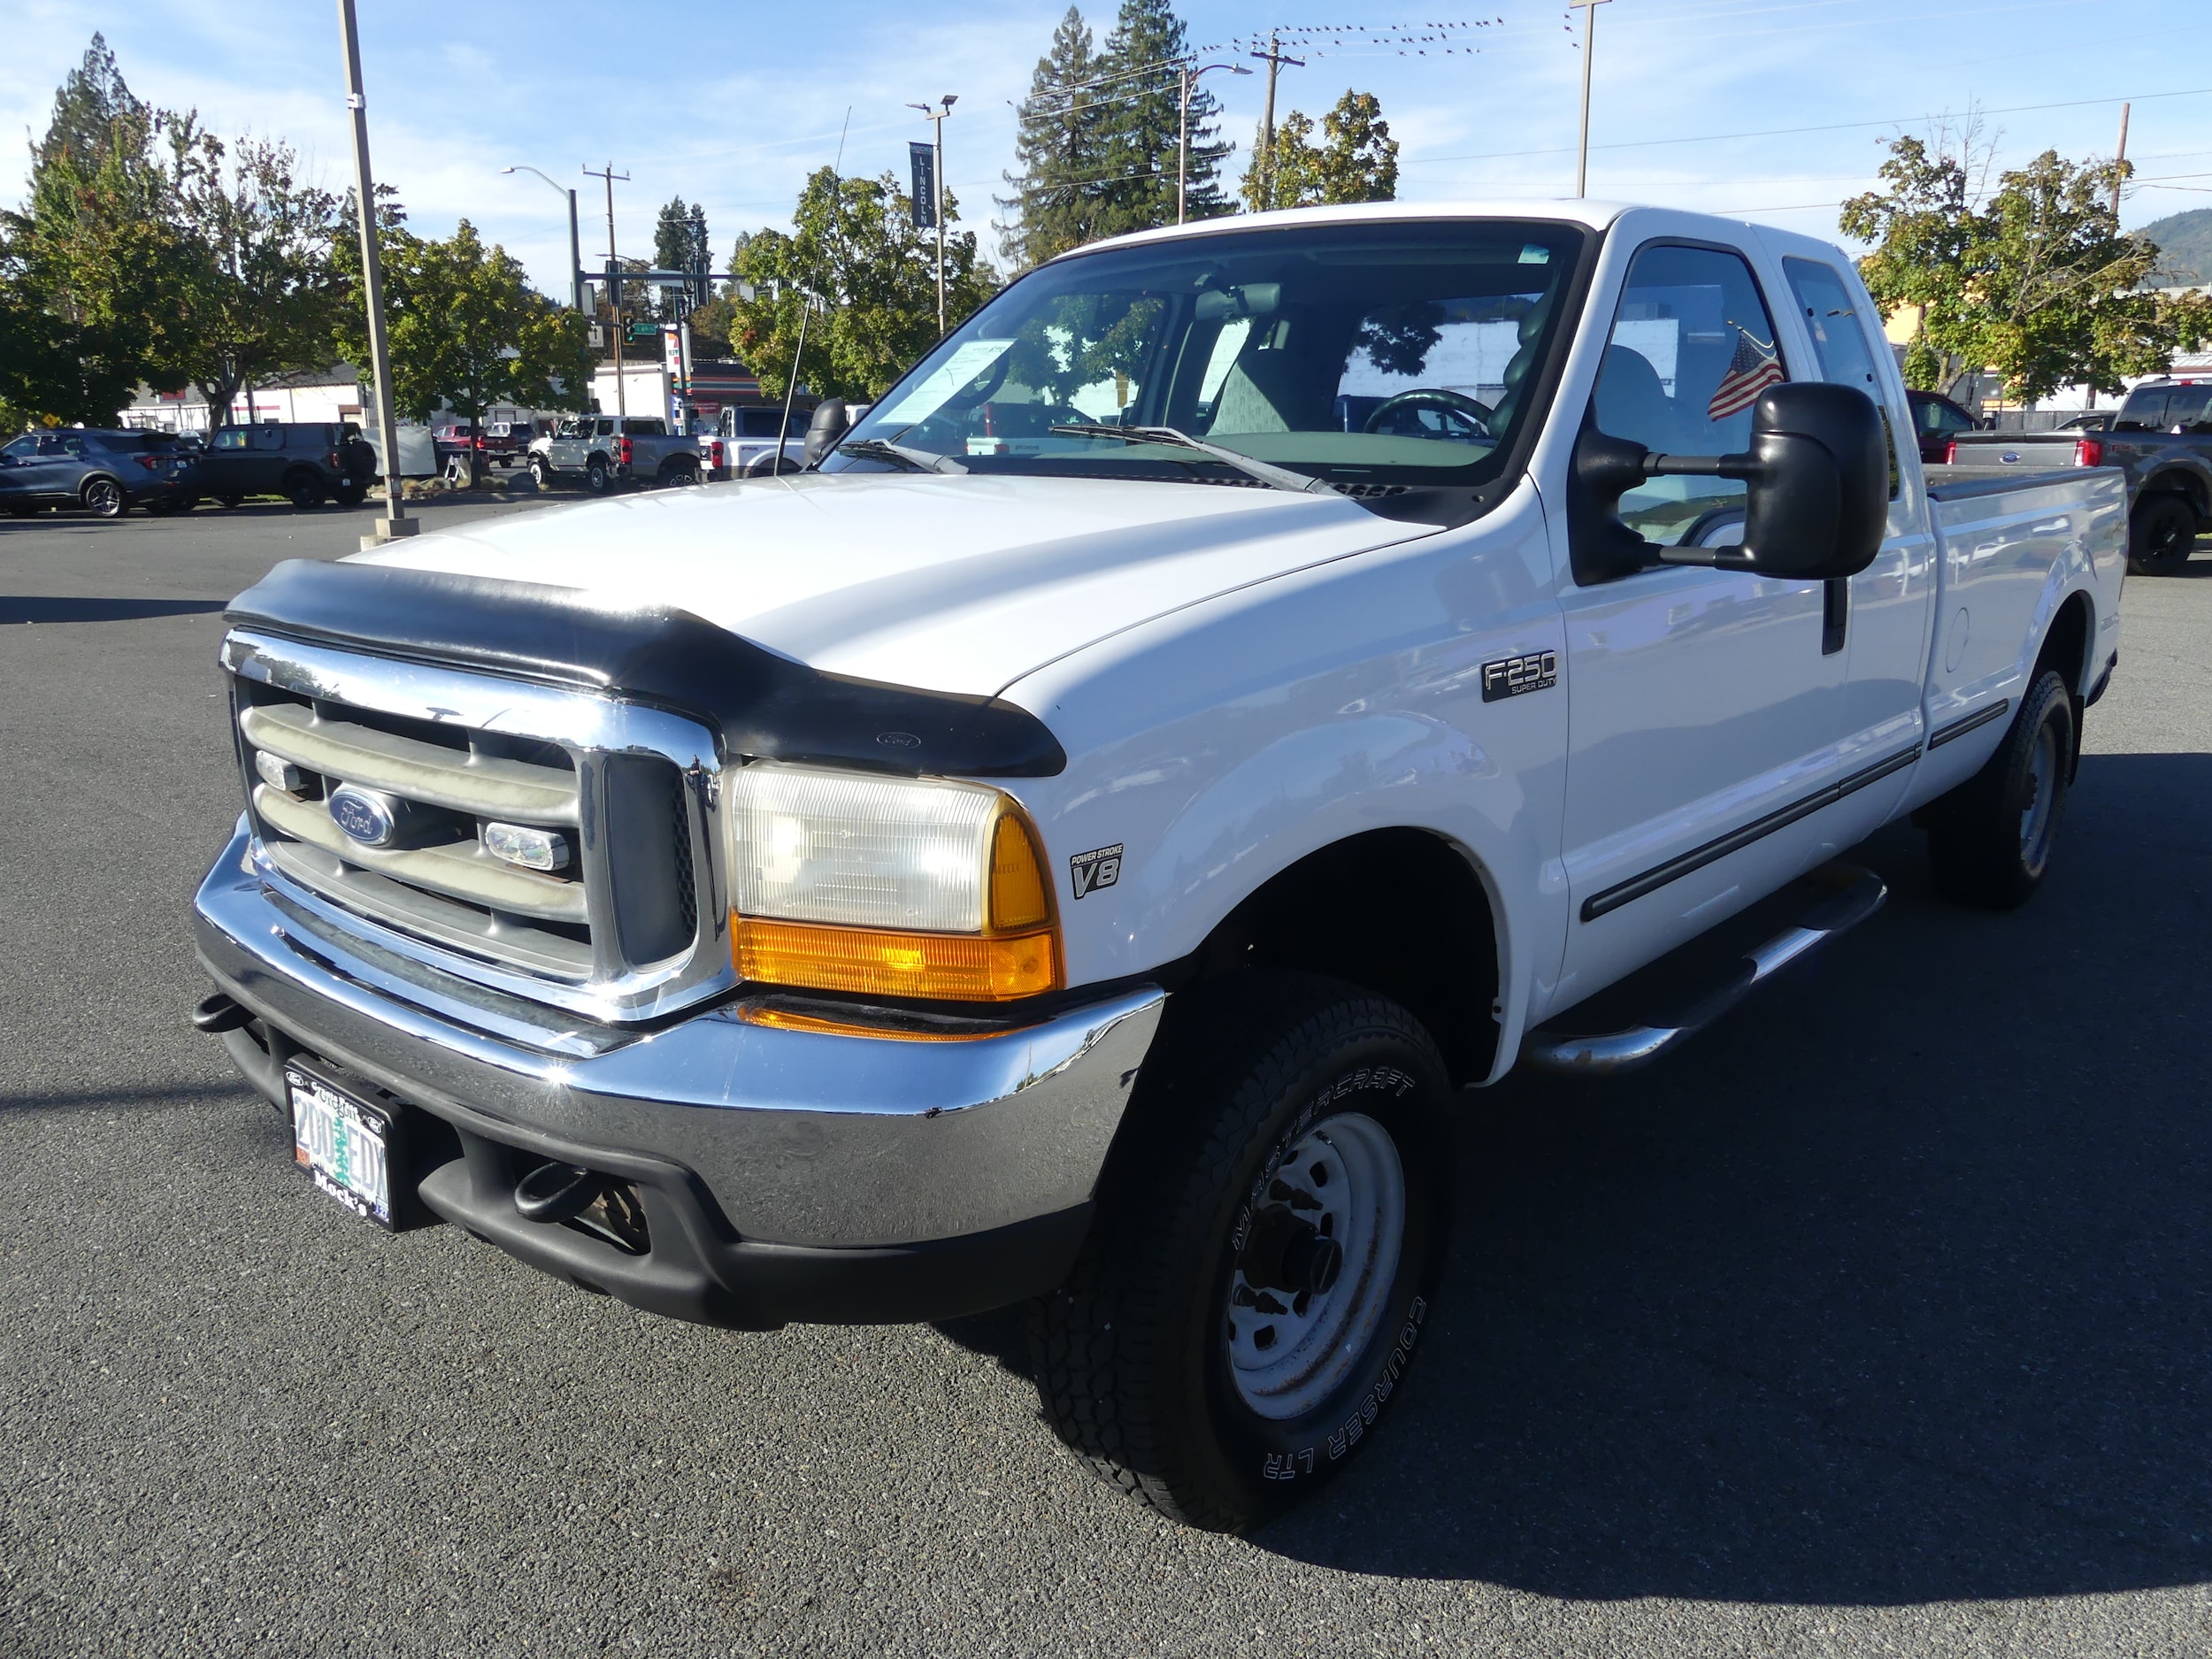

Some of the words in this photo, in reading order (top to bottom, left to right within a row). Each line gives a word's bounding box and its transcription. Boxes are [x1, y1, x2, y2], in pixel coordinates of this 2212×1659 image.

[1511, 682, 1536, 695] SUPER
[1538, 677, 1556, 688] DUTY
[341, 800, 373, 834] Ford
[1071, 851, 1097, 865] POWER
[1097, 844, 1123, 859] STROKE
[1073, 858, 1119, 897] V8
[311, 1081, 338, 1103] Grants
[339, 1096, 358, 1115] Pass
[319, 1089, 359, 1122] Oregon
[1232, 1065, 1416, 1251] MASTERCRAFT
[313, 1171, 368, 1217] Mock's
[1327, 1295, 1427, 1460] COURSER
[1263, 1447, 1314, 1479] LTR
